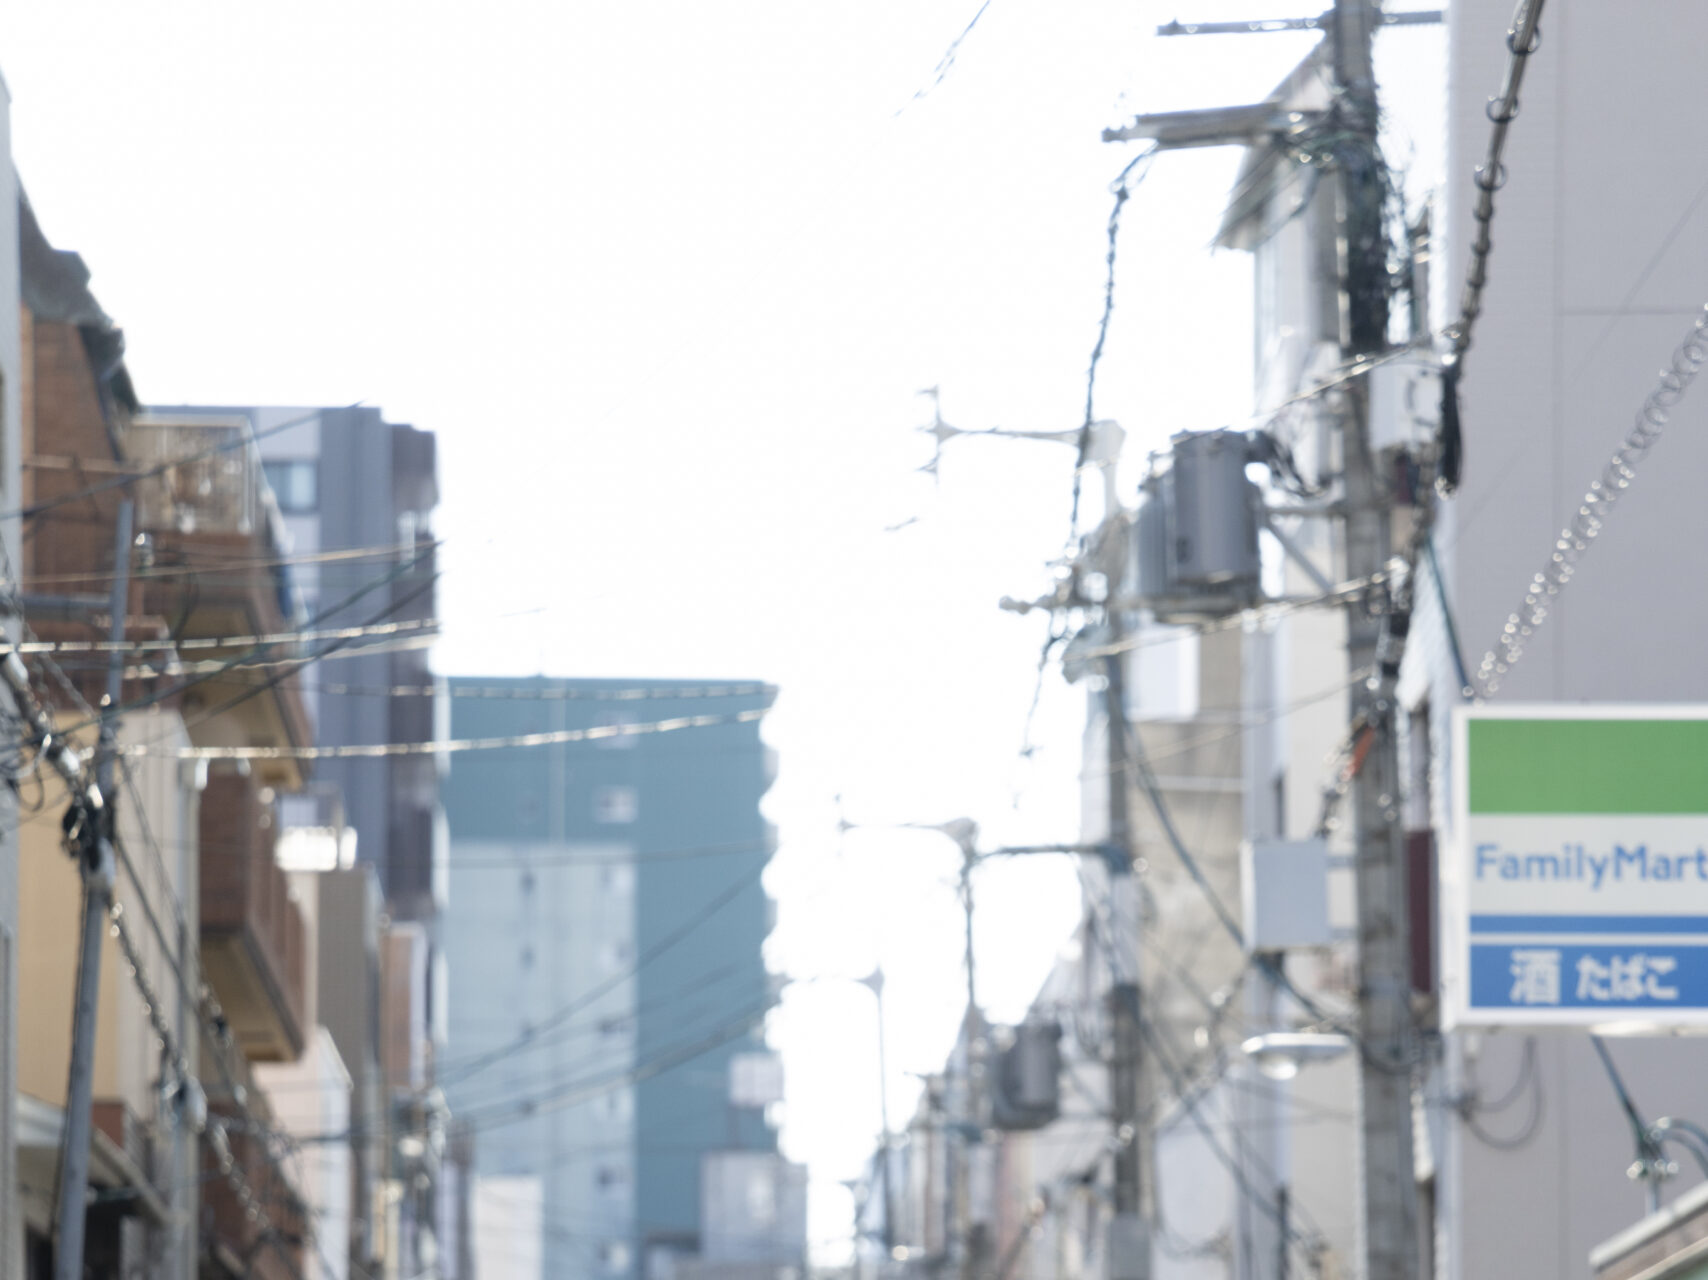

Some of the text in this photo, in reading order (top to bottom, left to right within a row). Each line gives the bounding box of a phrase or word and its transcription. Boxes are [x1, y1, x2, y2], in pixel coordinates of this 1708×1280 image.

[1475, 844, 1708, 890] FamilyMart
[1510, 949, 1679, 1004] 酒 たばこ
